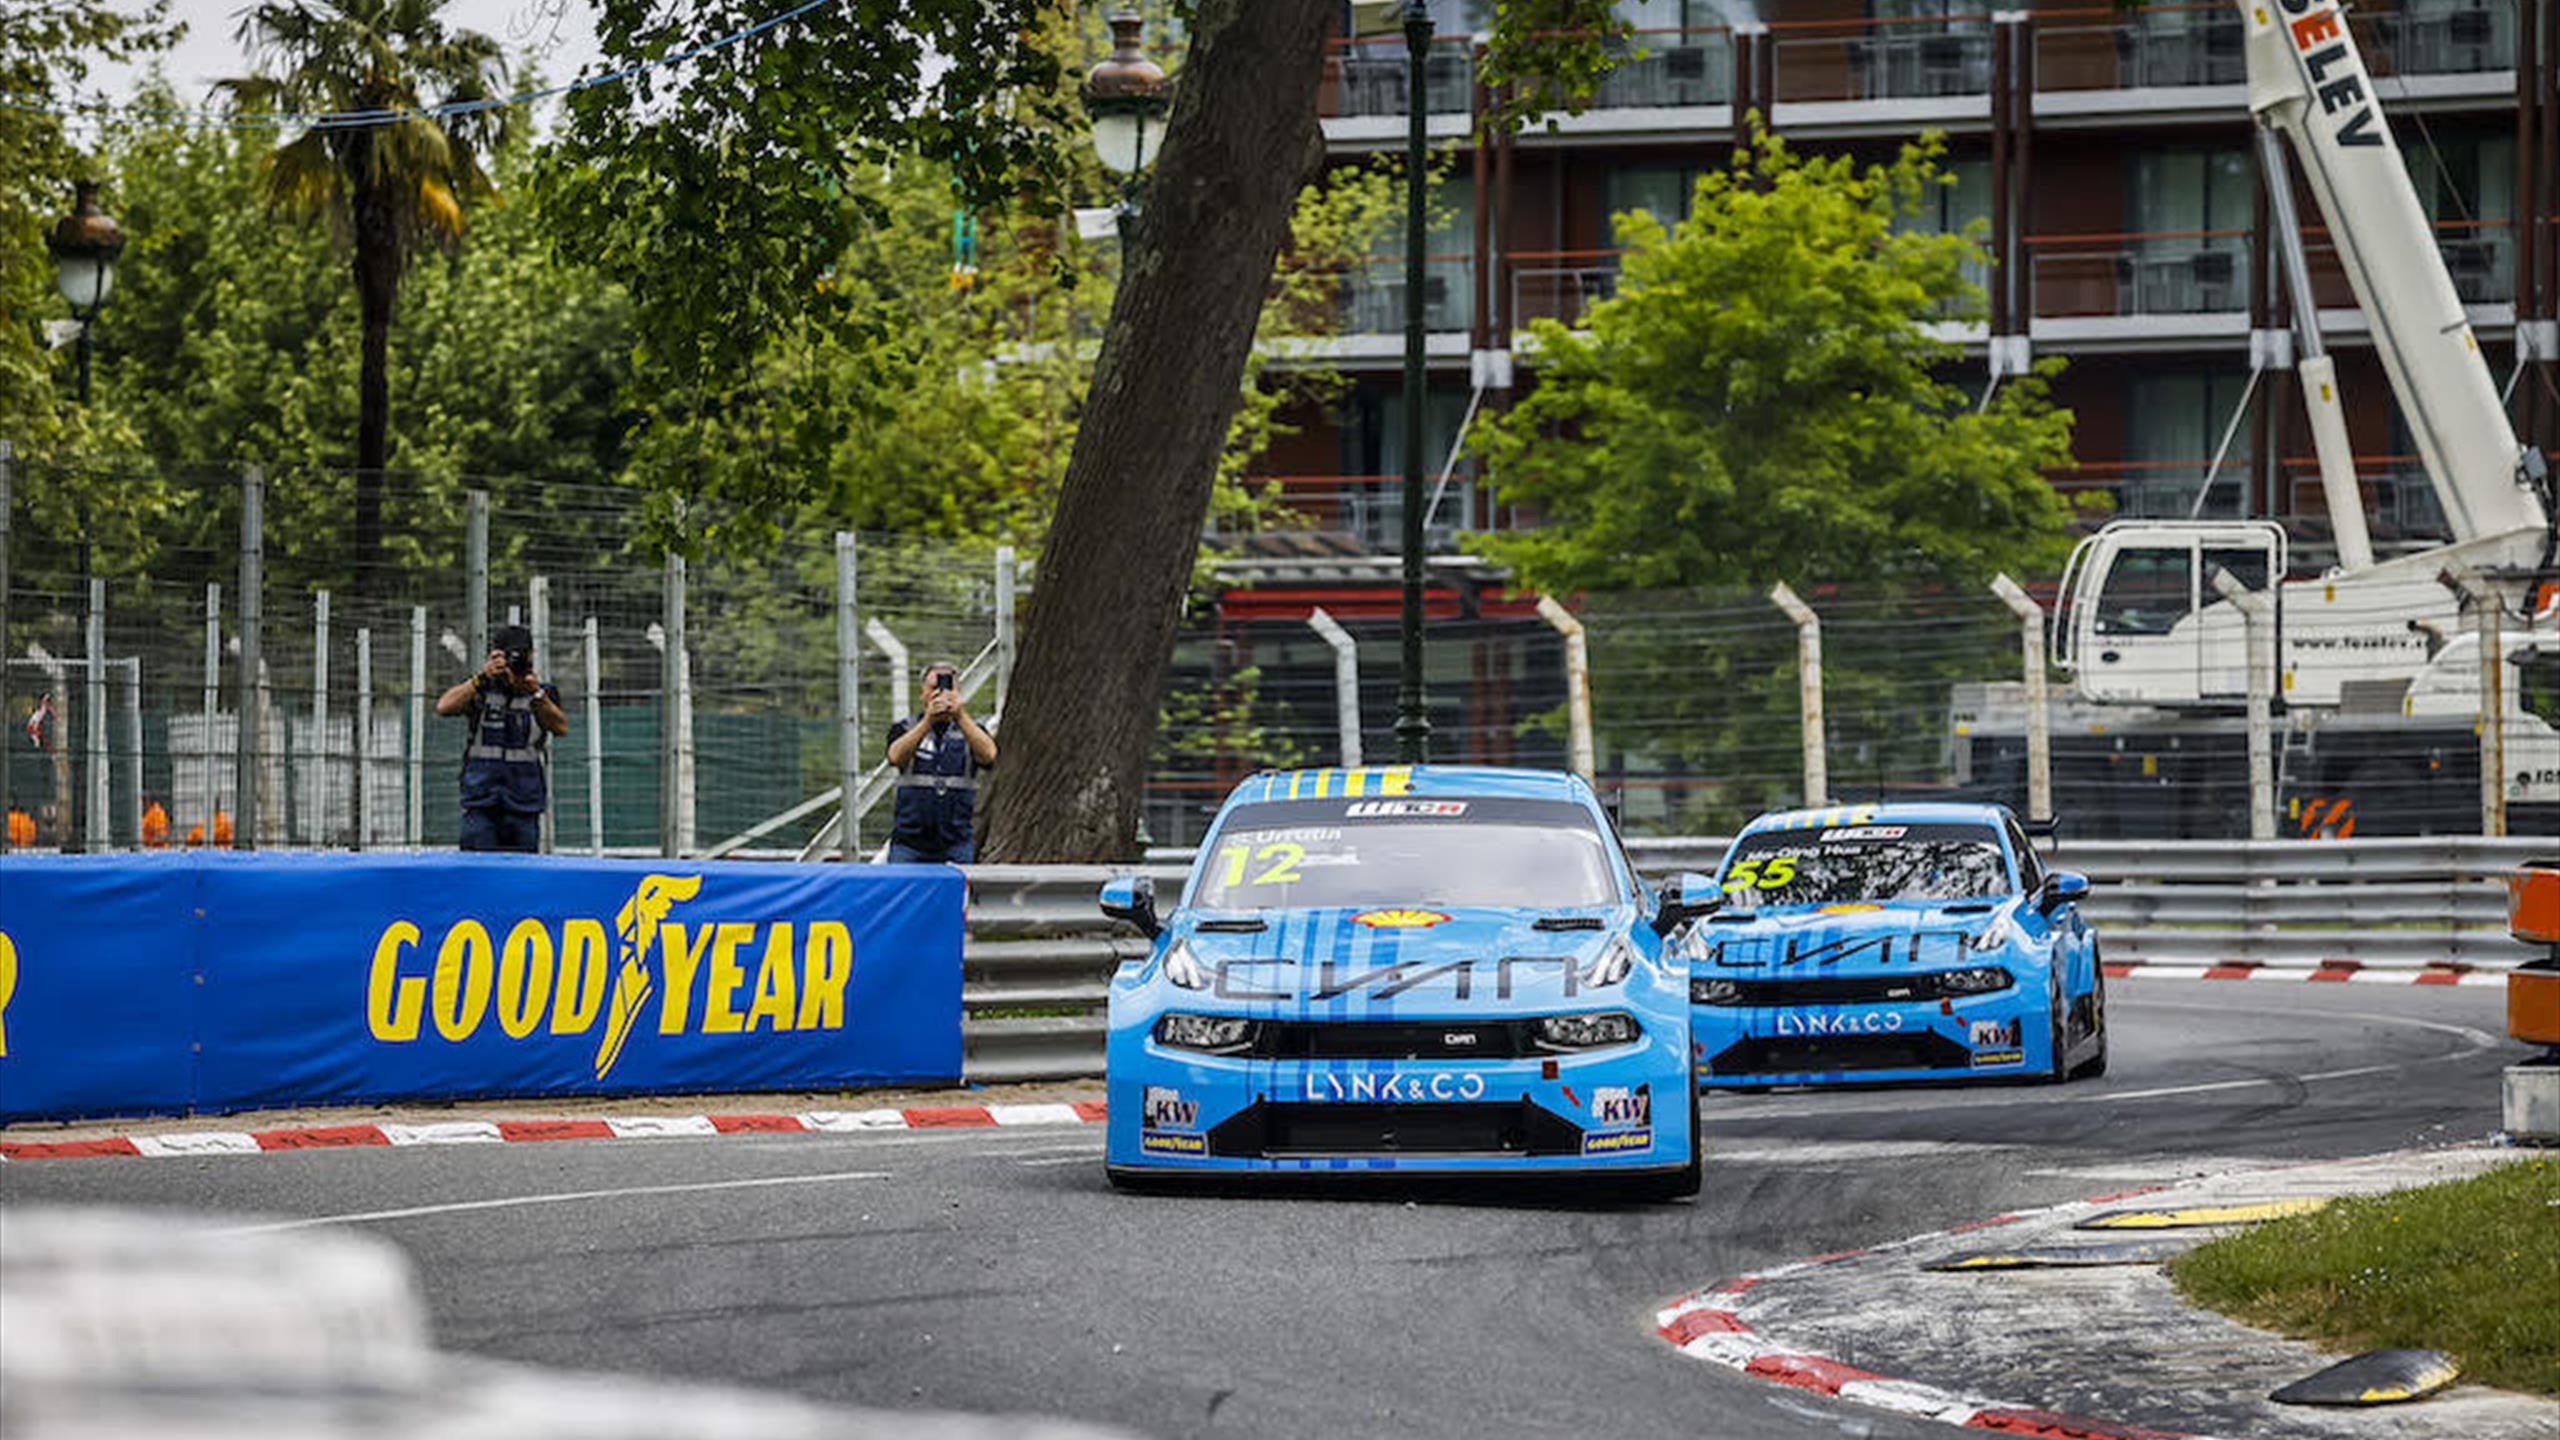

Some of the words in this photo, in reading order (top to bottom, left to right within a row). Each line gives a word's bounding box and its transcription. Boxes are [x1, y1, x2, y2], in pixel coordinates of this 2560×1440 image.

[1220, 843, 1306, 888] 12
[1722, 857, 1798, 893] 55
[1156, 1100, 1198, 1125] KW
[1603, 1098, 1646, 1123] KW
